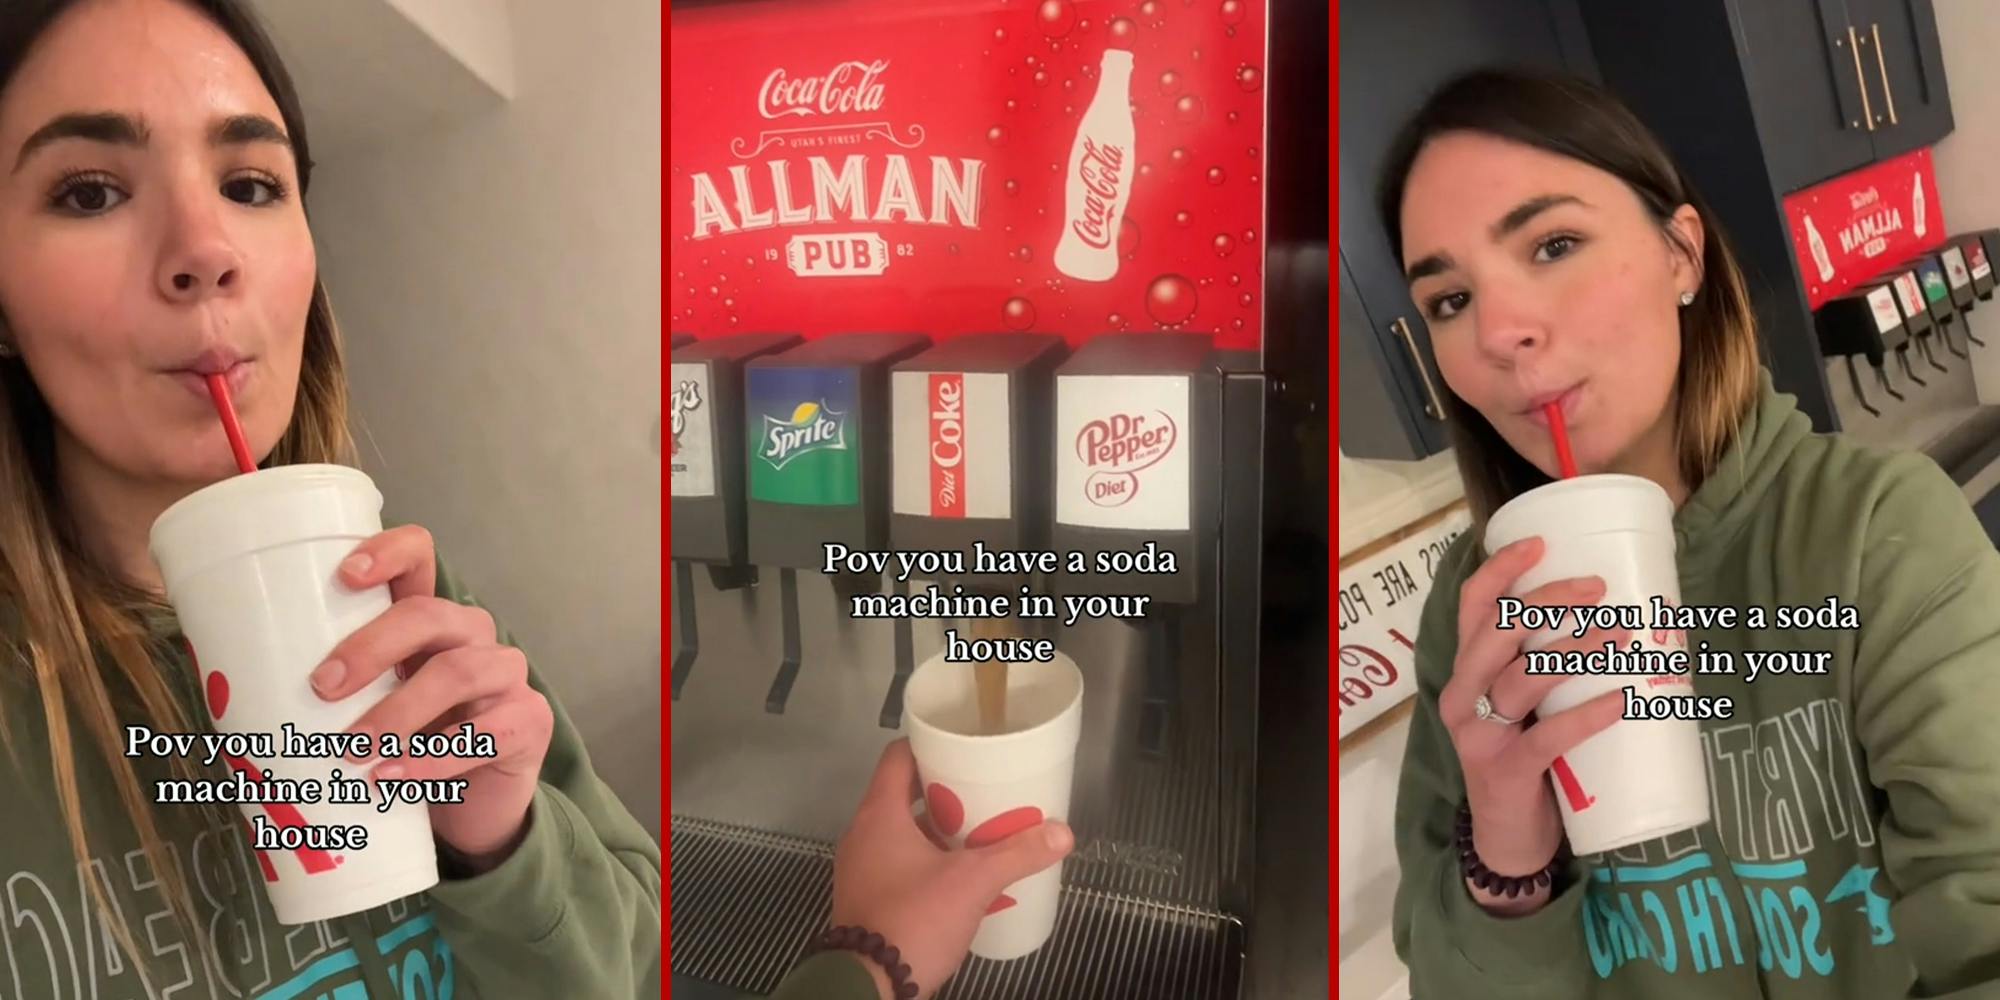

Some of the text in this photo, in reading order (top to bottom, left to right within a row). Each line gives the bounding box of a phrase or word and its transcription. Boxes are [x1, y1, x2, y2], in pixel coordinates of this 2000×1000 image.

[759, 59, 889, 118] Coca-Cola
[828, 133, 861, 146] FINEST
[690, 154, 986, 239] ALLMAN
[1073, 134, 1124, 249] Coca-Cola
[764, 239, 914, 270] 19 PUB 82
[766, 416, 836, 459] Sprite
[931, 380, 962, 507] Diet Coke
[1086, 419, 1169, 467] Pepper
[1110, 413, 1146, 441] Dr
[1094, 478, 1127, 499] Diet
